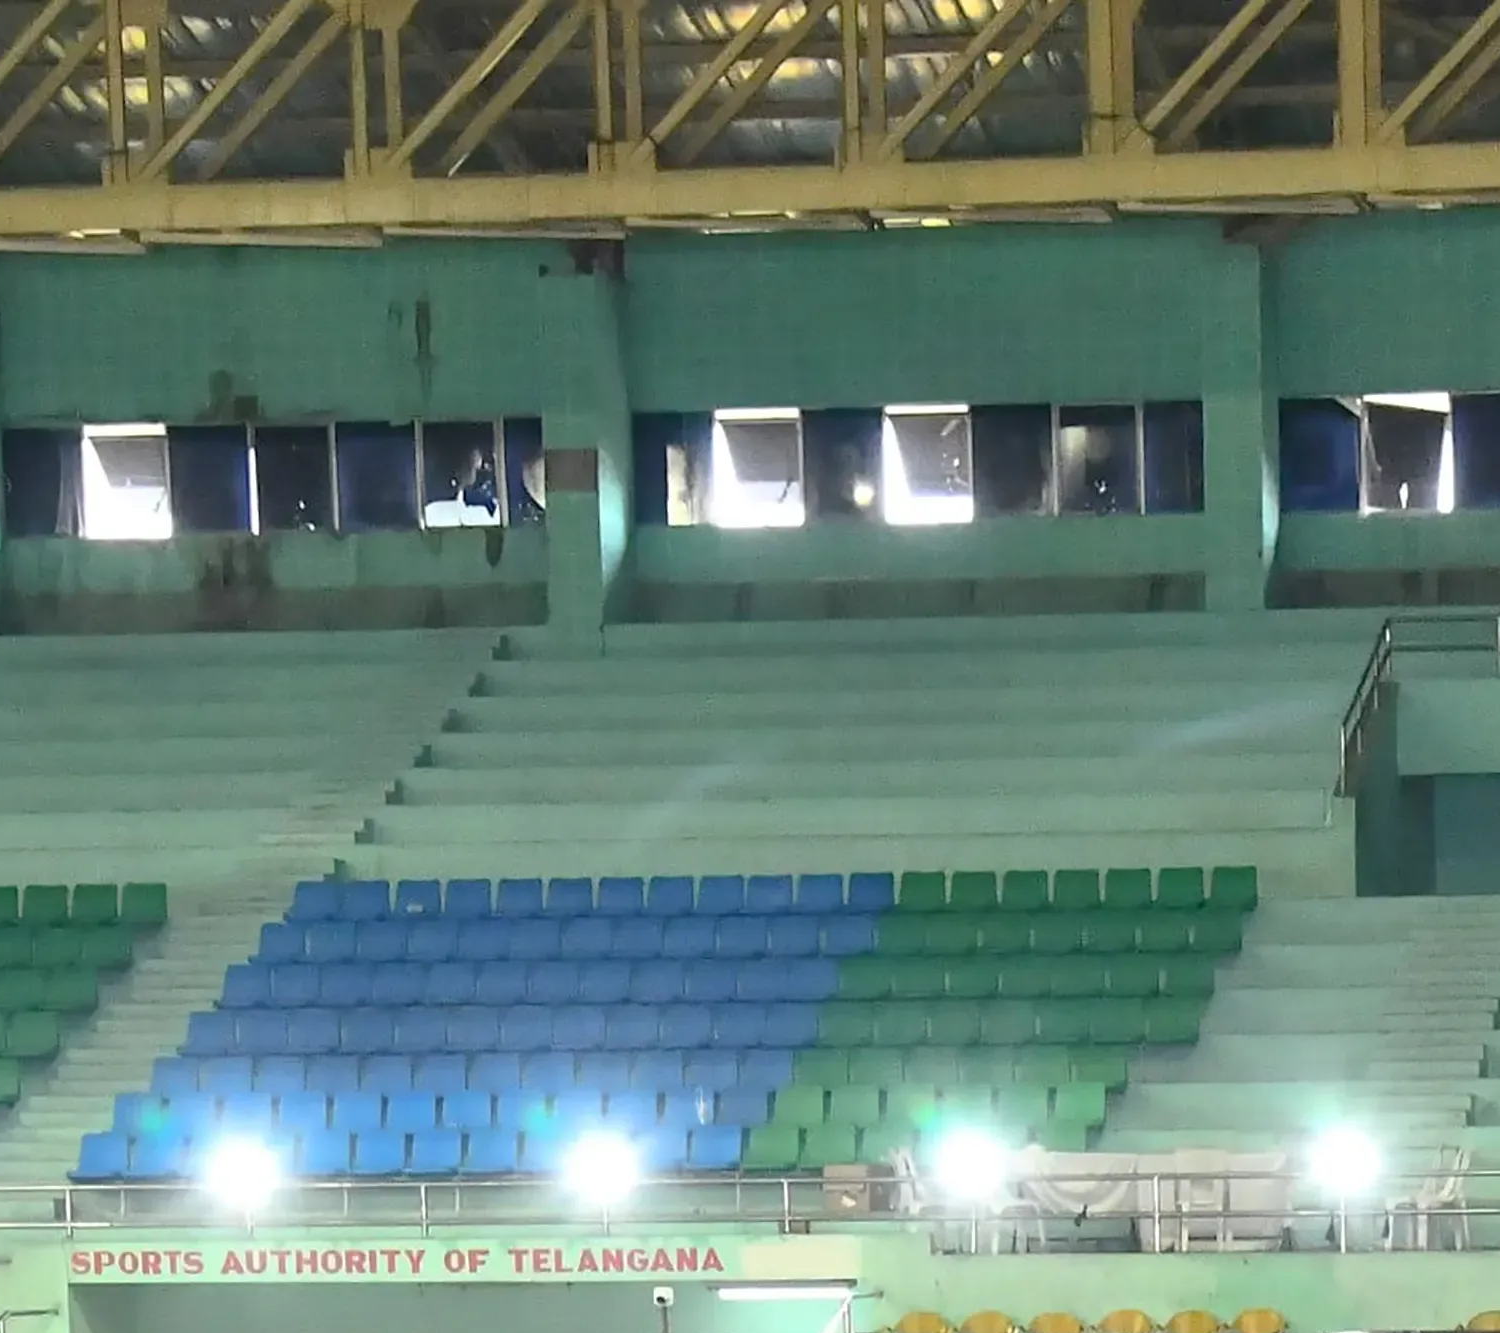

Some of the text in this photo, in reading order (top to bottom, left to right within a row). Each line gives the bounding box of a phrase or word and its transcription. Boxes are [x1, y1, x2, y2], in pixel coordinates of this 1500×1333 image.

[71, 1247, 725, 1275] SPORTS AUTHORITY OF TELANGANA
